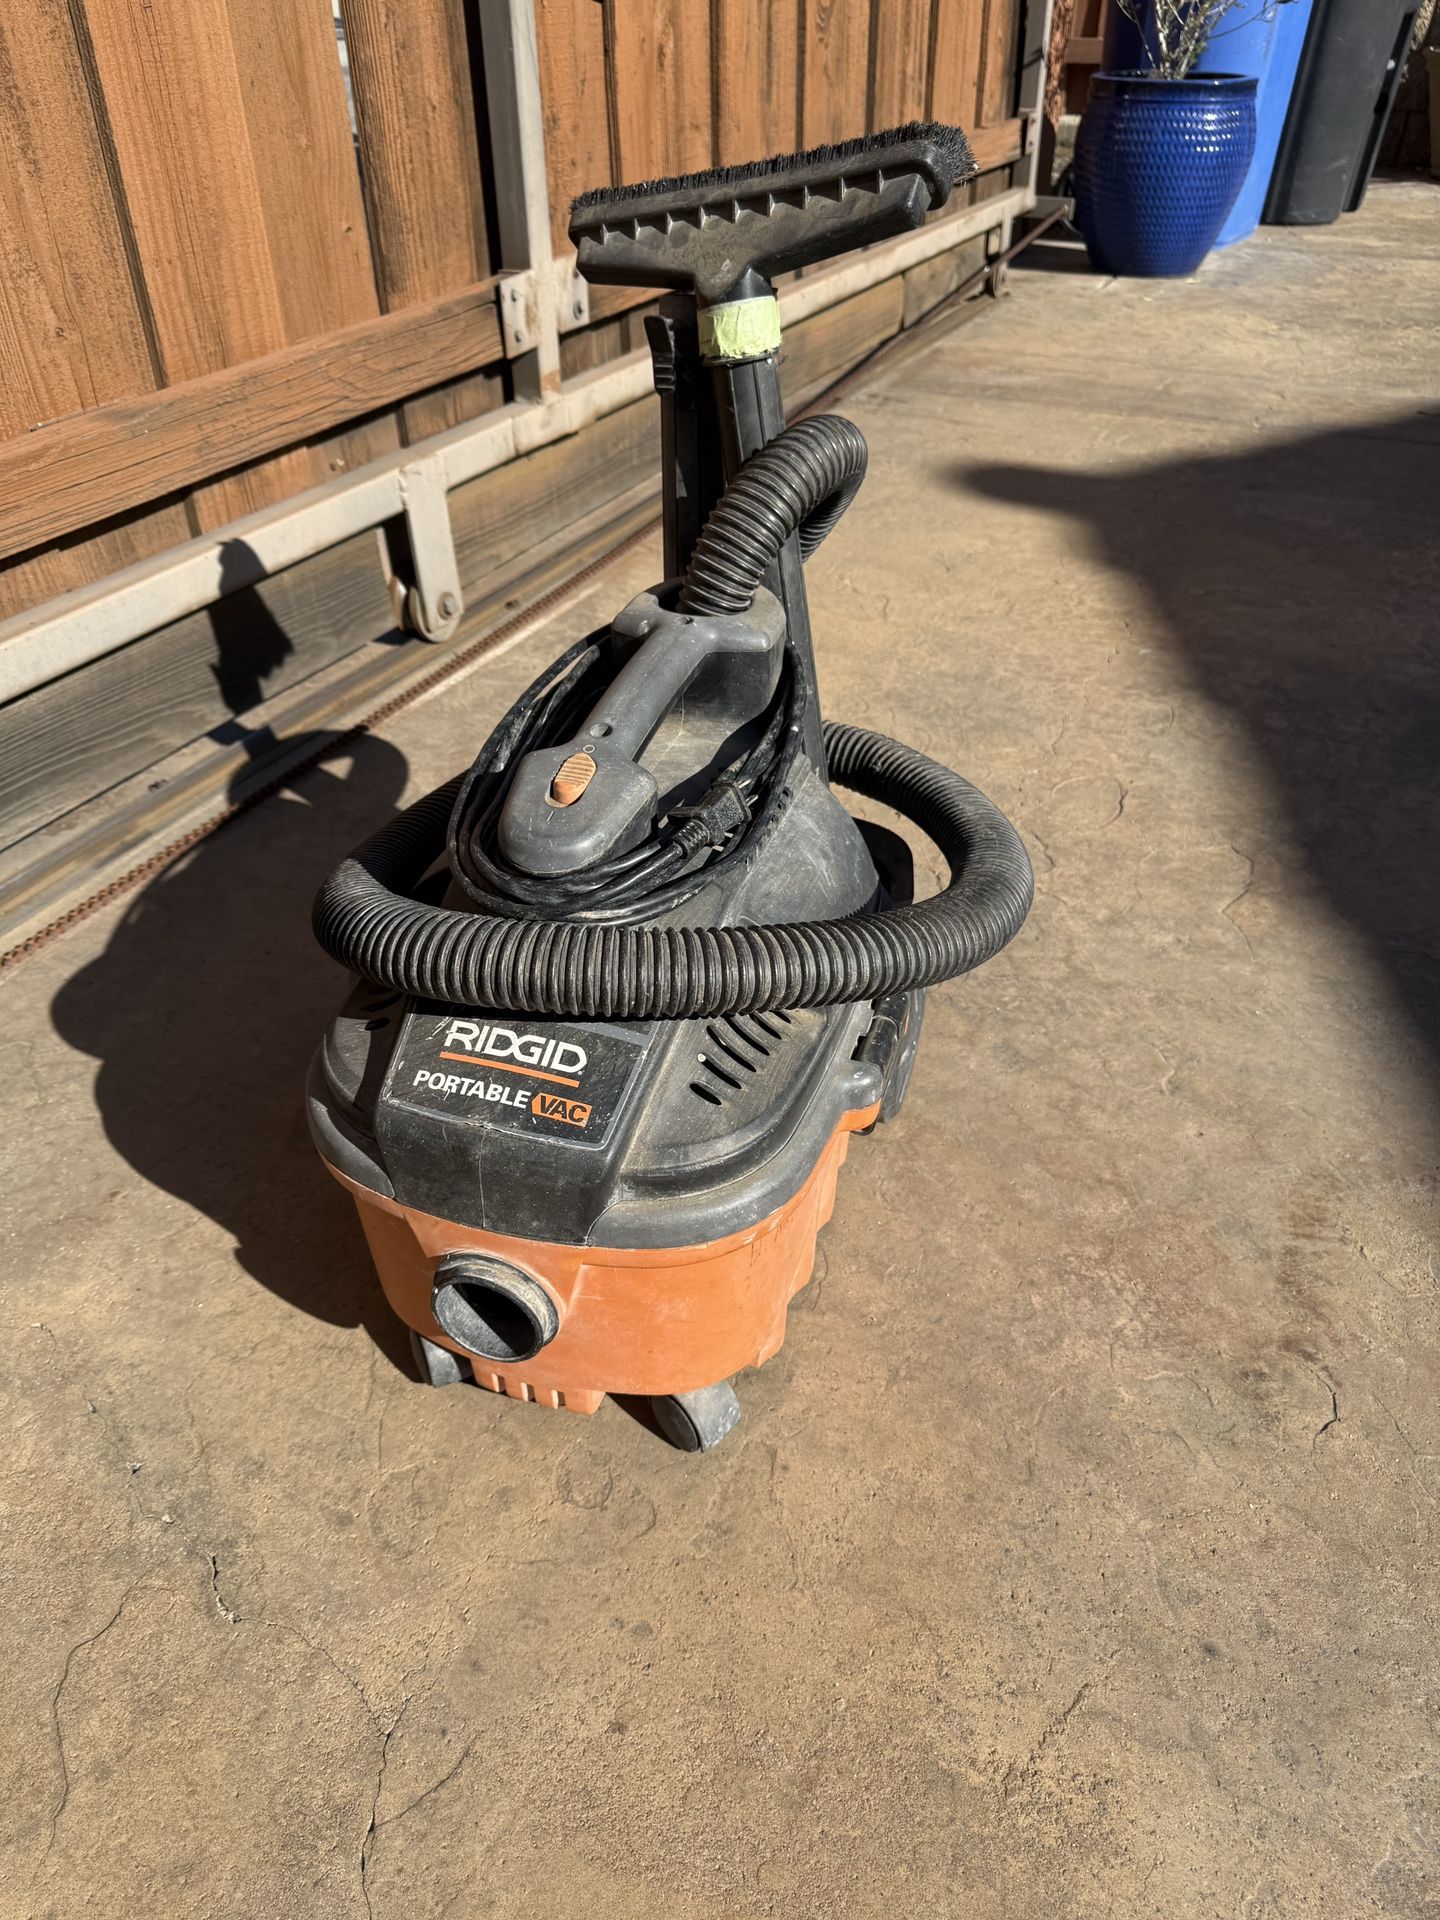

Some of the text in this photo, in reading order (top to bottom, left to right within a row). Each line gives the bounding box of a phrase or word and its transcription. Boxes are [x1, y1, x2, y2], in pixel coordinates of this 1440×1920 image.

[444, 1020, 587, 1073] RIDGID
[413, 1070, 588, 1123] PORTABLE VAC
